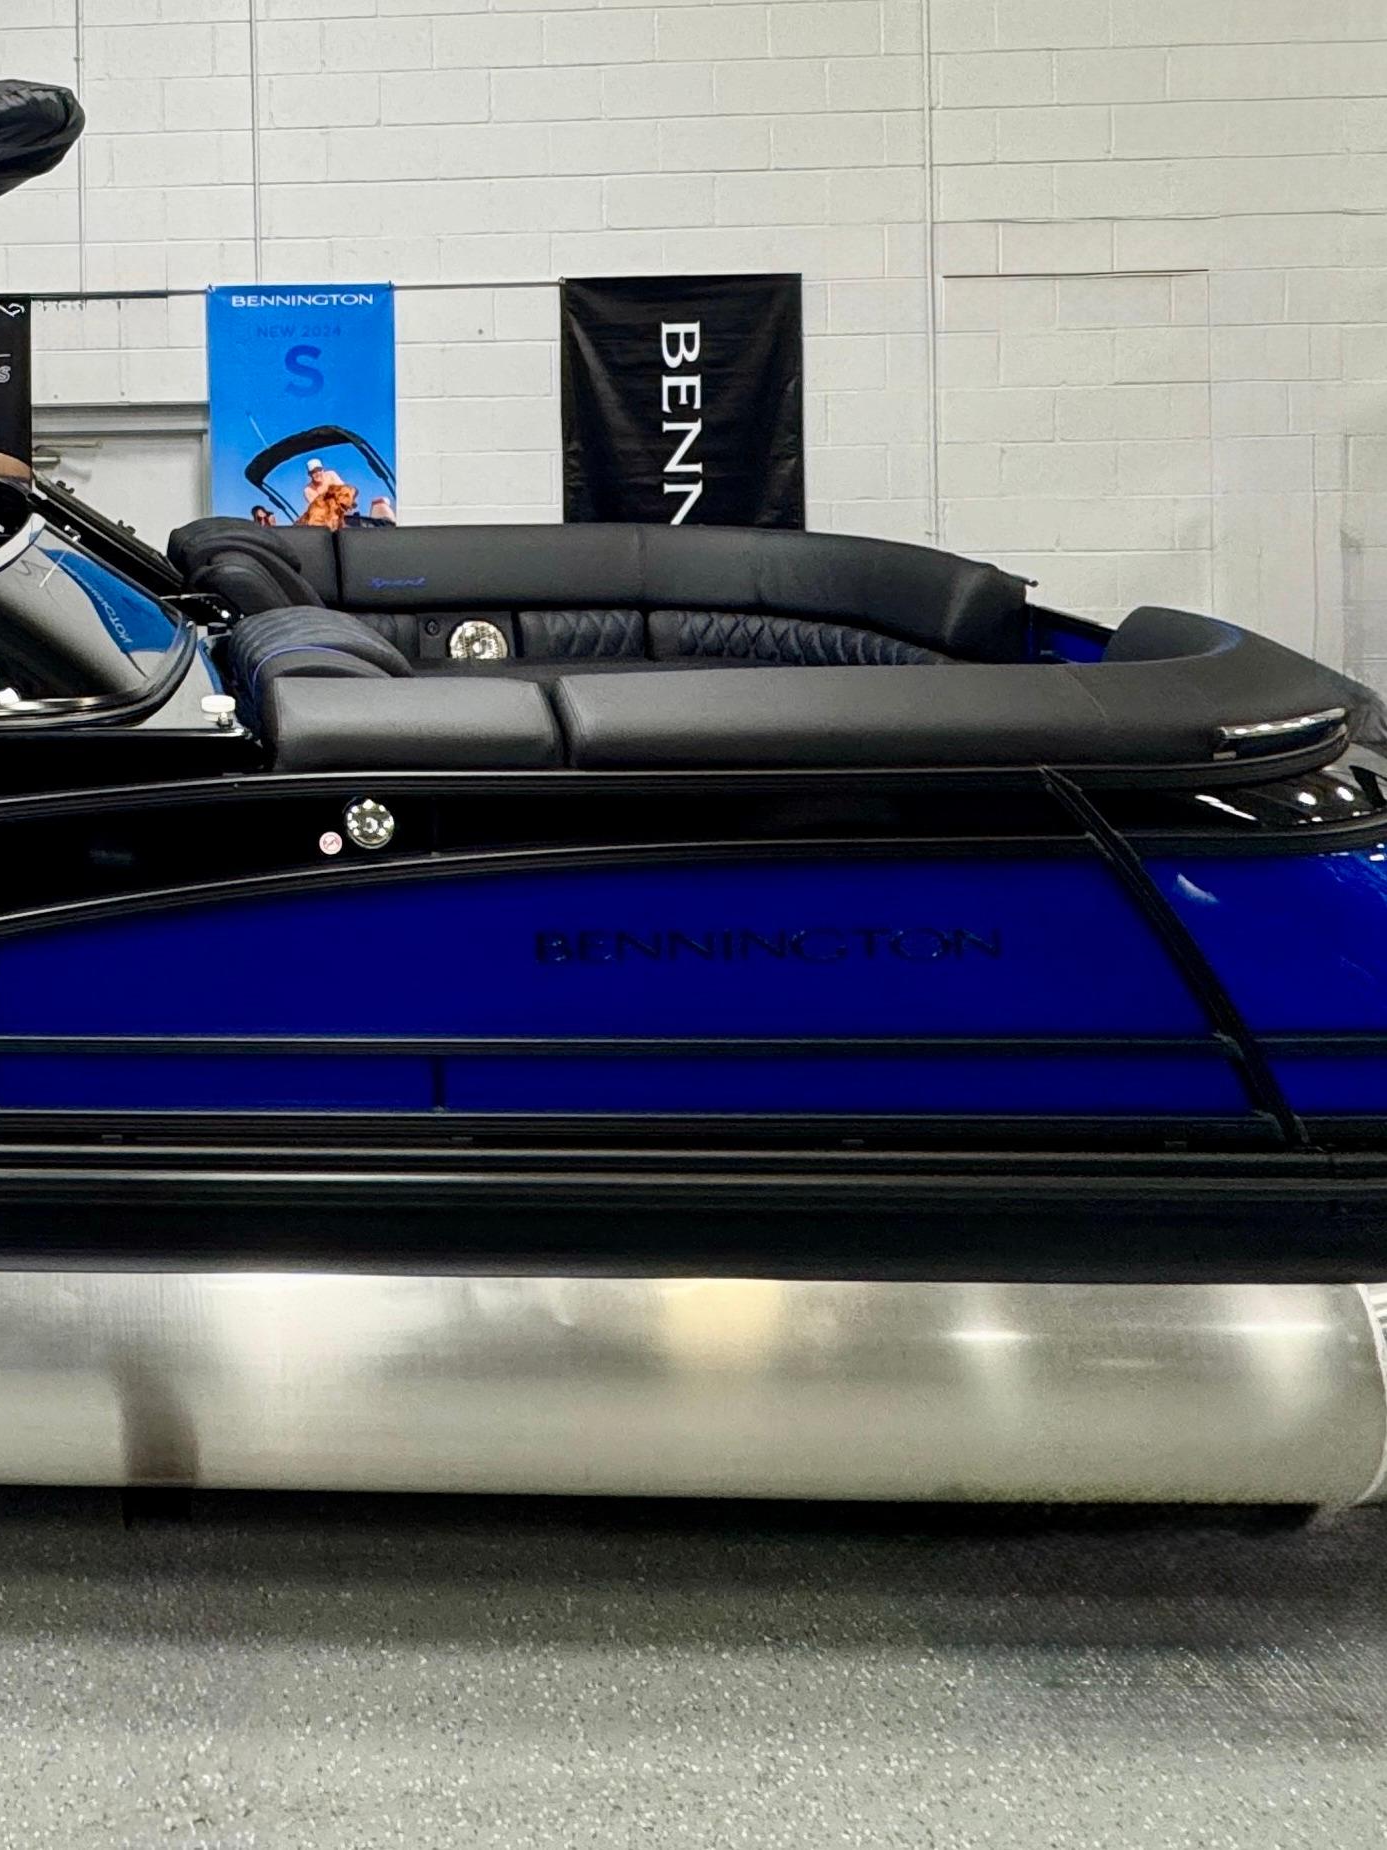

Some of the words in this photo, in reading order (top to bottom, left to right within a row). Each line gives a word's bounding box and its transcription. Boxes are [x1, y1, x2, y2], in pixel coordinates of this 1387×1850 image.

[231, 293, 374, 307] BENNINGTON
[256, 324, 297, 338] NEW
[301, 324, 341, 337] 2024
[284, 344, 324, 398] S
[534, 928, 1004, 962] BENNINGTON
